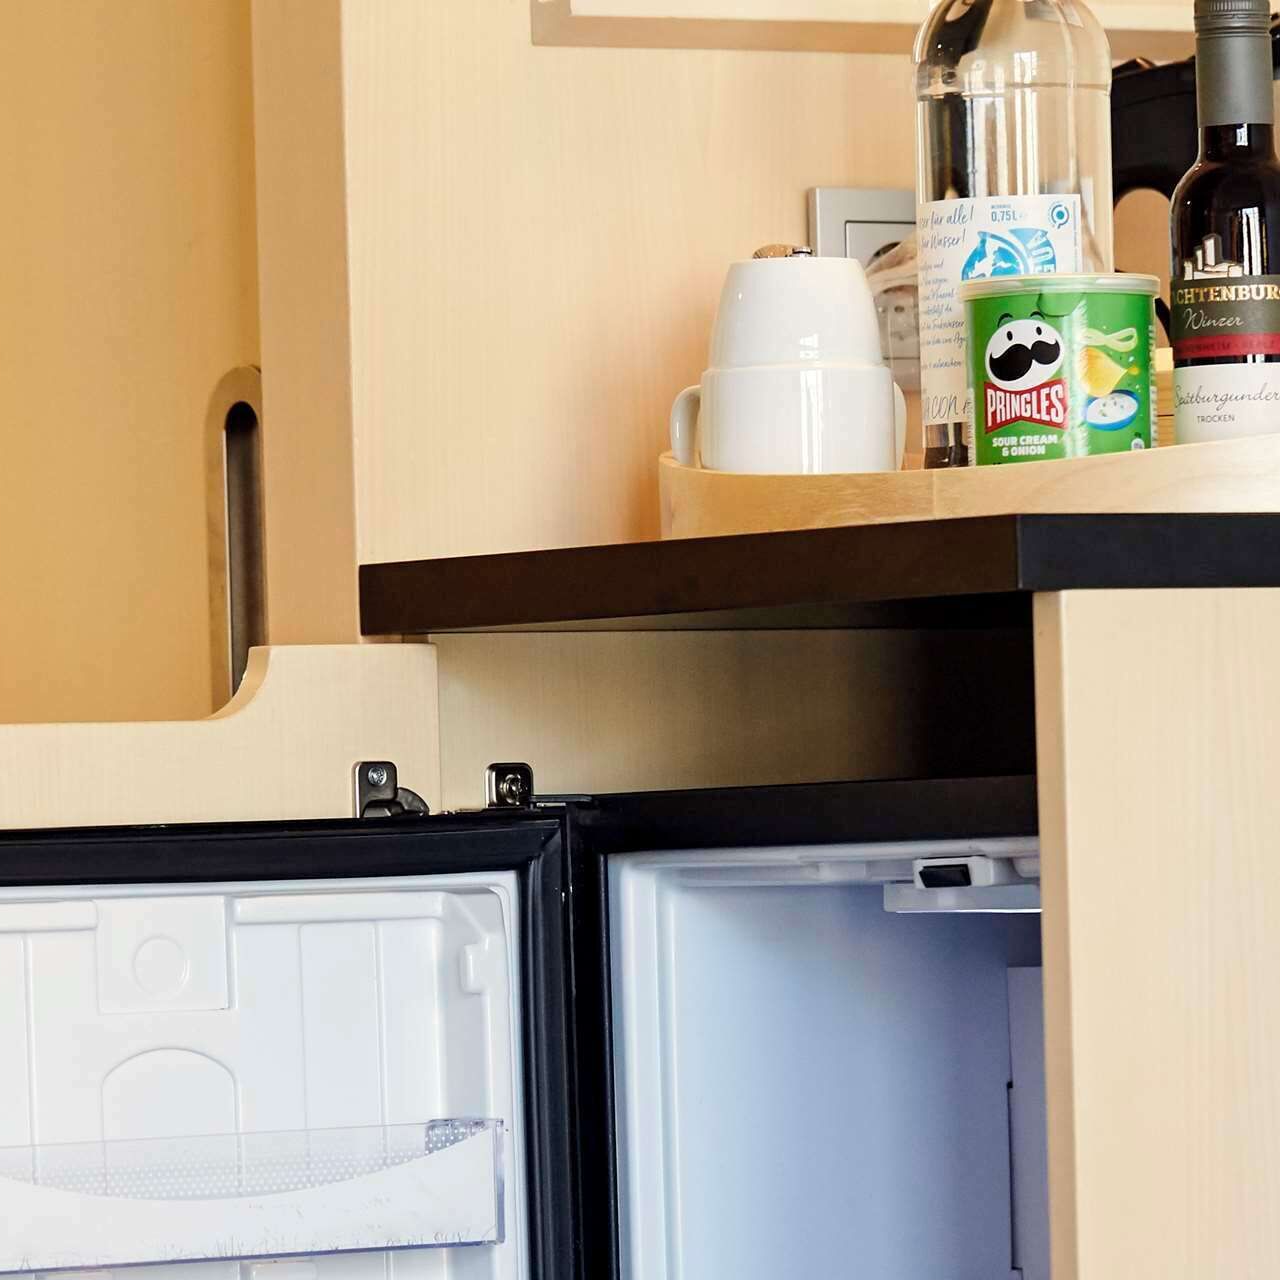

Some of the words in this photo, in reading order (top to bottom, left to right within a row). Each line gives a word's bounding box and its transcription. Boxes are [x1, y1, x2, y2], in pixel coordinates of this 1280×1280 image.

[1184, 307, 1244, 330] Winzer
[986, 383, 1065, 428] PRINGLES
[1196, 414, 1236, 424] TROCKEN
[992, 436, 1019, 447] SOUR
[1020, 434, 1059, 446] CREAM
[1010, 444, 1046, 456] ONION
